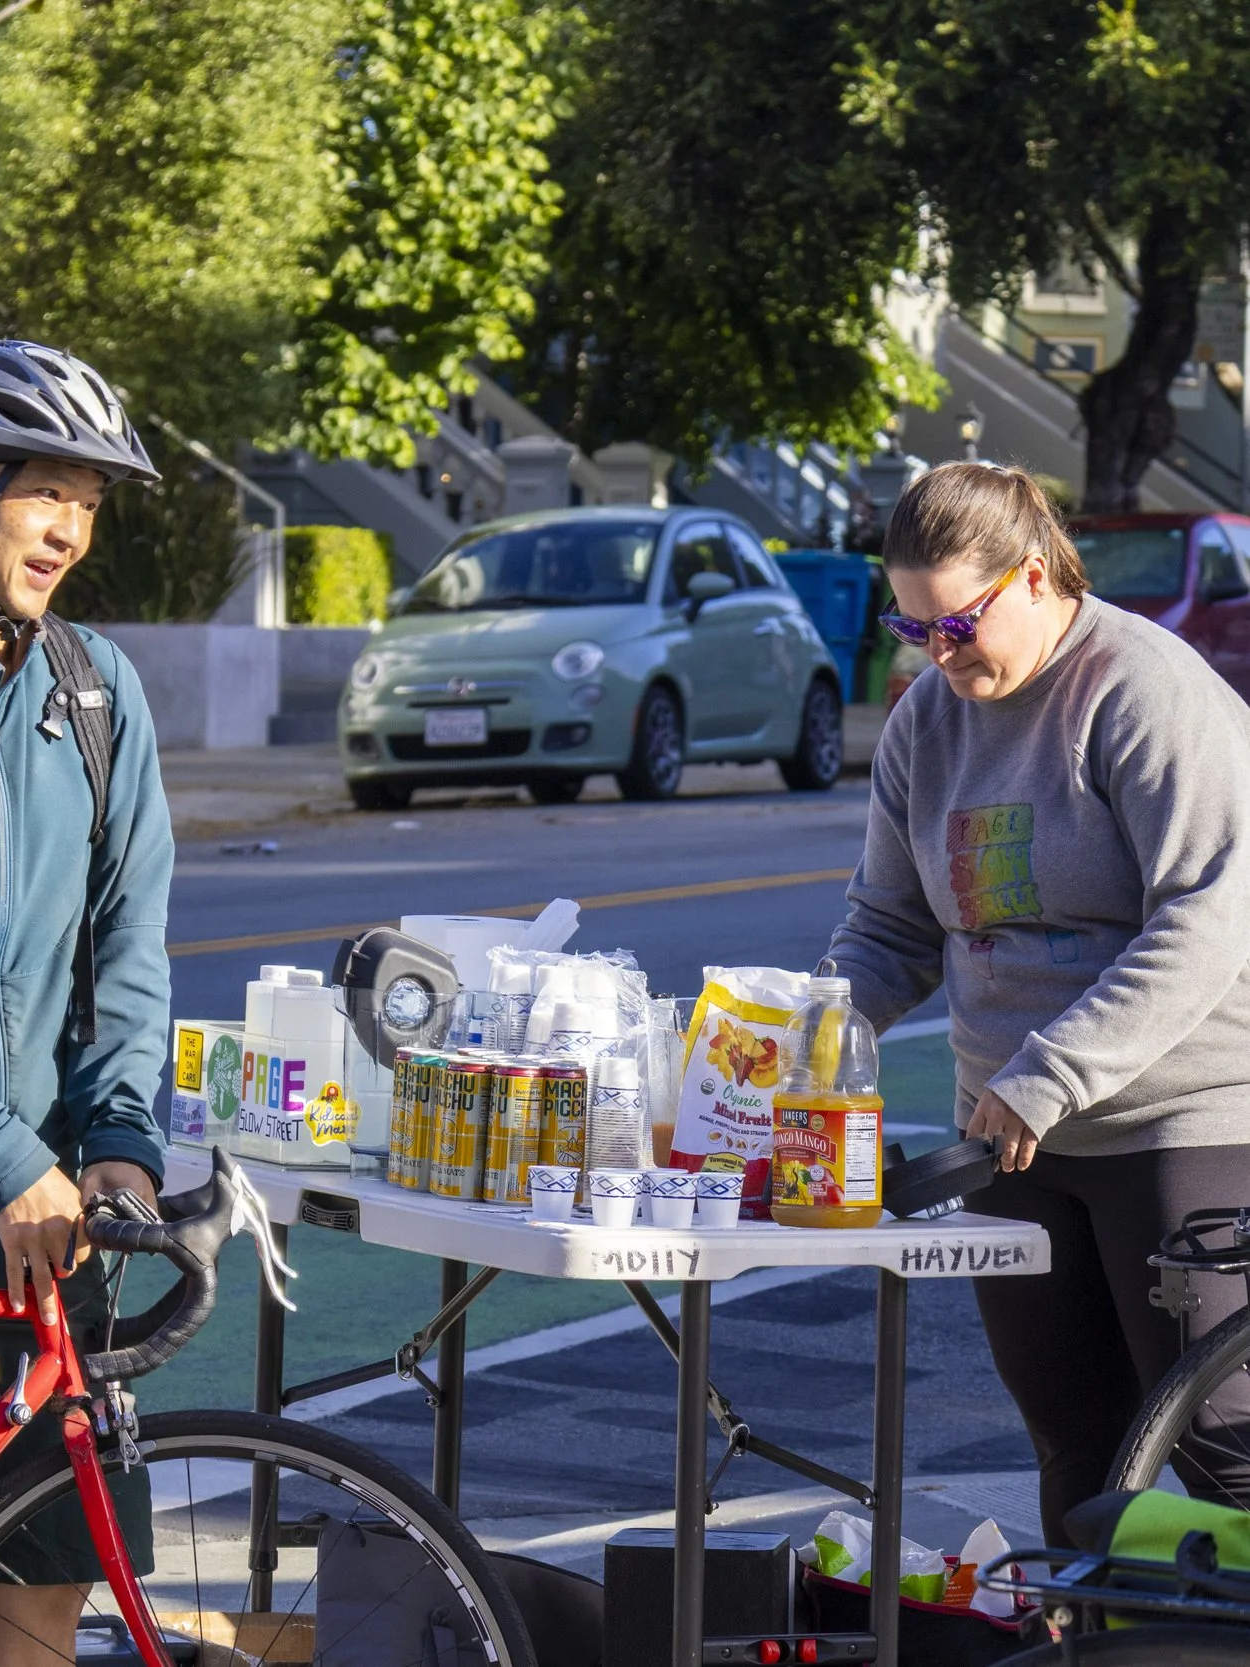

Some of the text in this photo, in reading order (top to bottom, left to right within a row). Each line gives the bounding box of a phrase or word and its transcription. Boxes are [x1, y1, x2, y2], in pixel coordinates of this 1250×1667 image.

[960, 810, 1018, 842] PAGE
[186, 1037, 196, 1048] THE
[185, 1049, 196, 1058] WAR
[186, 1061, 194, 1070] ON
[182, 1071, 196, 1083] CARS
[242, 1051, 306, 1112] PAGE
[172, 1099, 187, 1111] GREAT
[737, 1111, 772, 1126] Fruit
[782, 1110, 808, 1125] LANGERS
[239, 1108, 304, 1141] SLOW STREET
[443, 1168, 466, 1177] MATE
[900, 1242, 1033, 1273] HAYDEN
